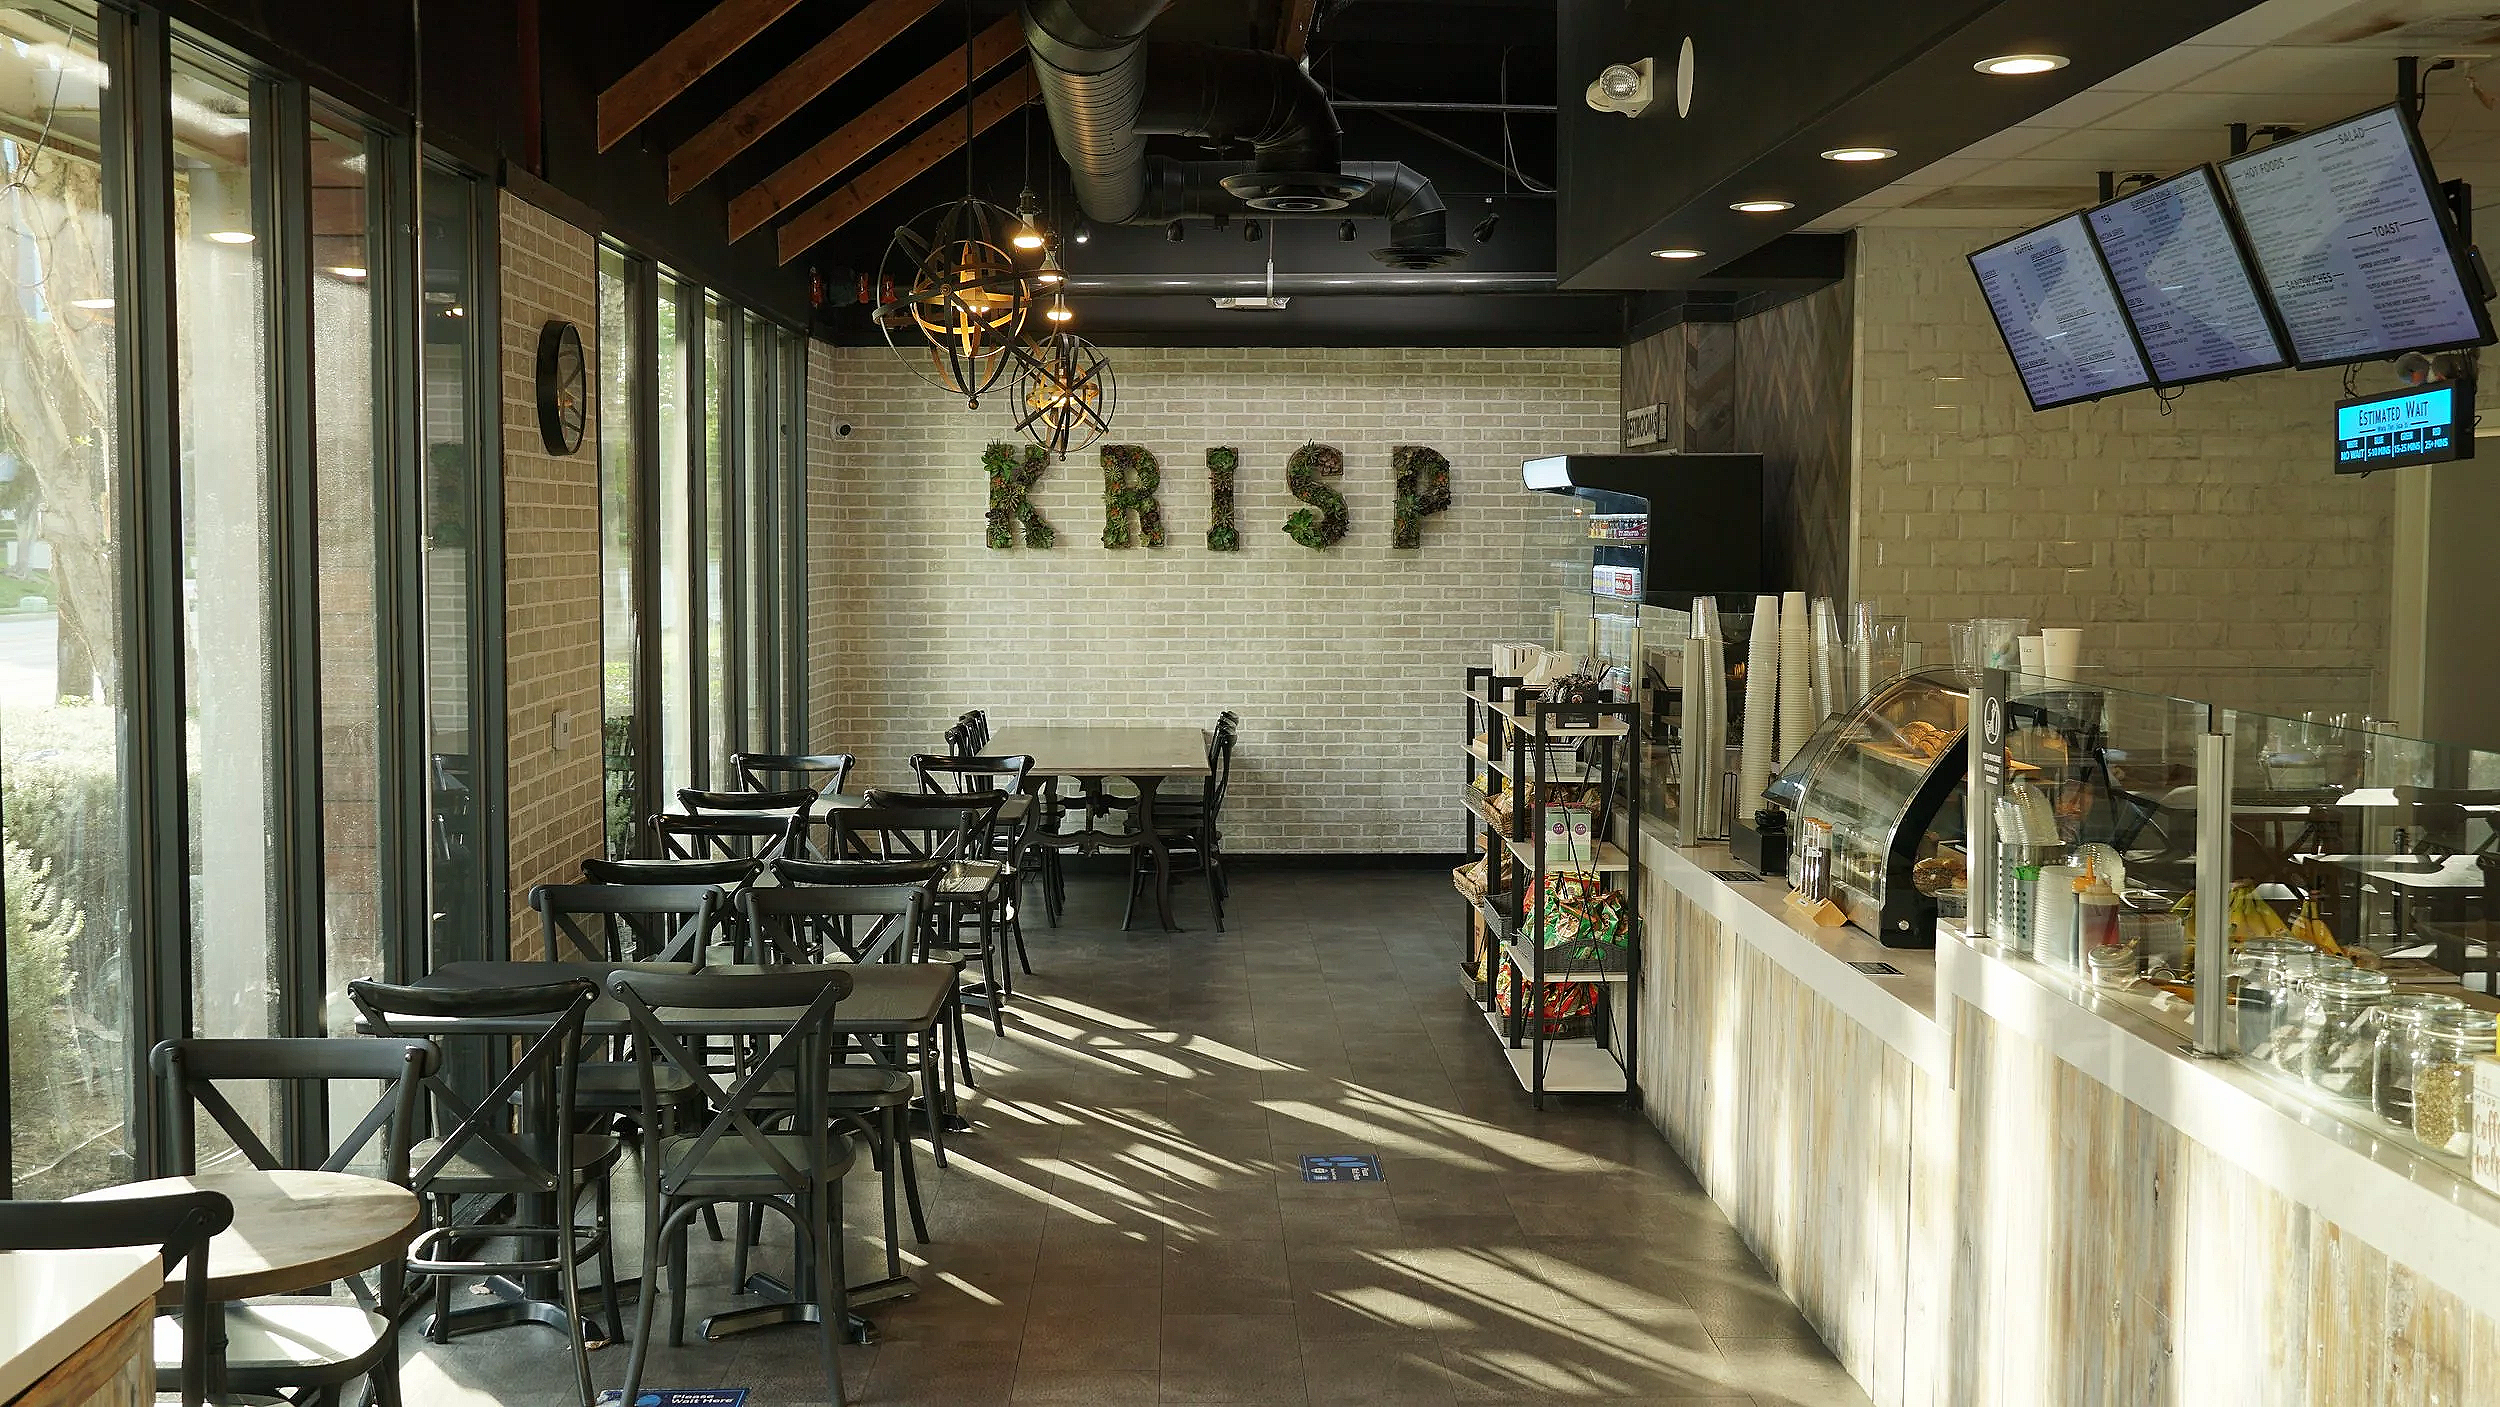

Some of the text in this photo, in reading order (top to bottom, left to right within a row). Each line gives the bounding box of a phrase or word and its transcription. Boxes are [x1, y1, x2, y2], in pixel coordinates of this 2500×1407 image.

[2338, 127, 2365, 144] SALAD
[2243, 157, 2285, 179] HOT FOODS
[2372, 222, 2401, 239] TOAST
[2285, 272, 2333, 291] SANDWICHES
[2359, 401, 2429, 426] ESTIMATED WAIT
[2340, 448, 2365, 461] NO WAIT
[981, 440, 1452, 551] KRISP
